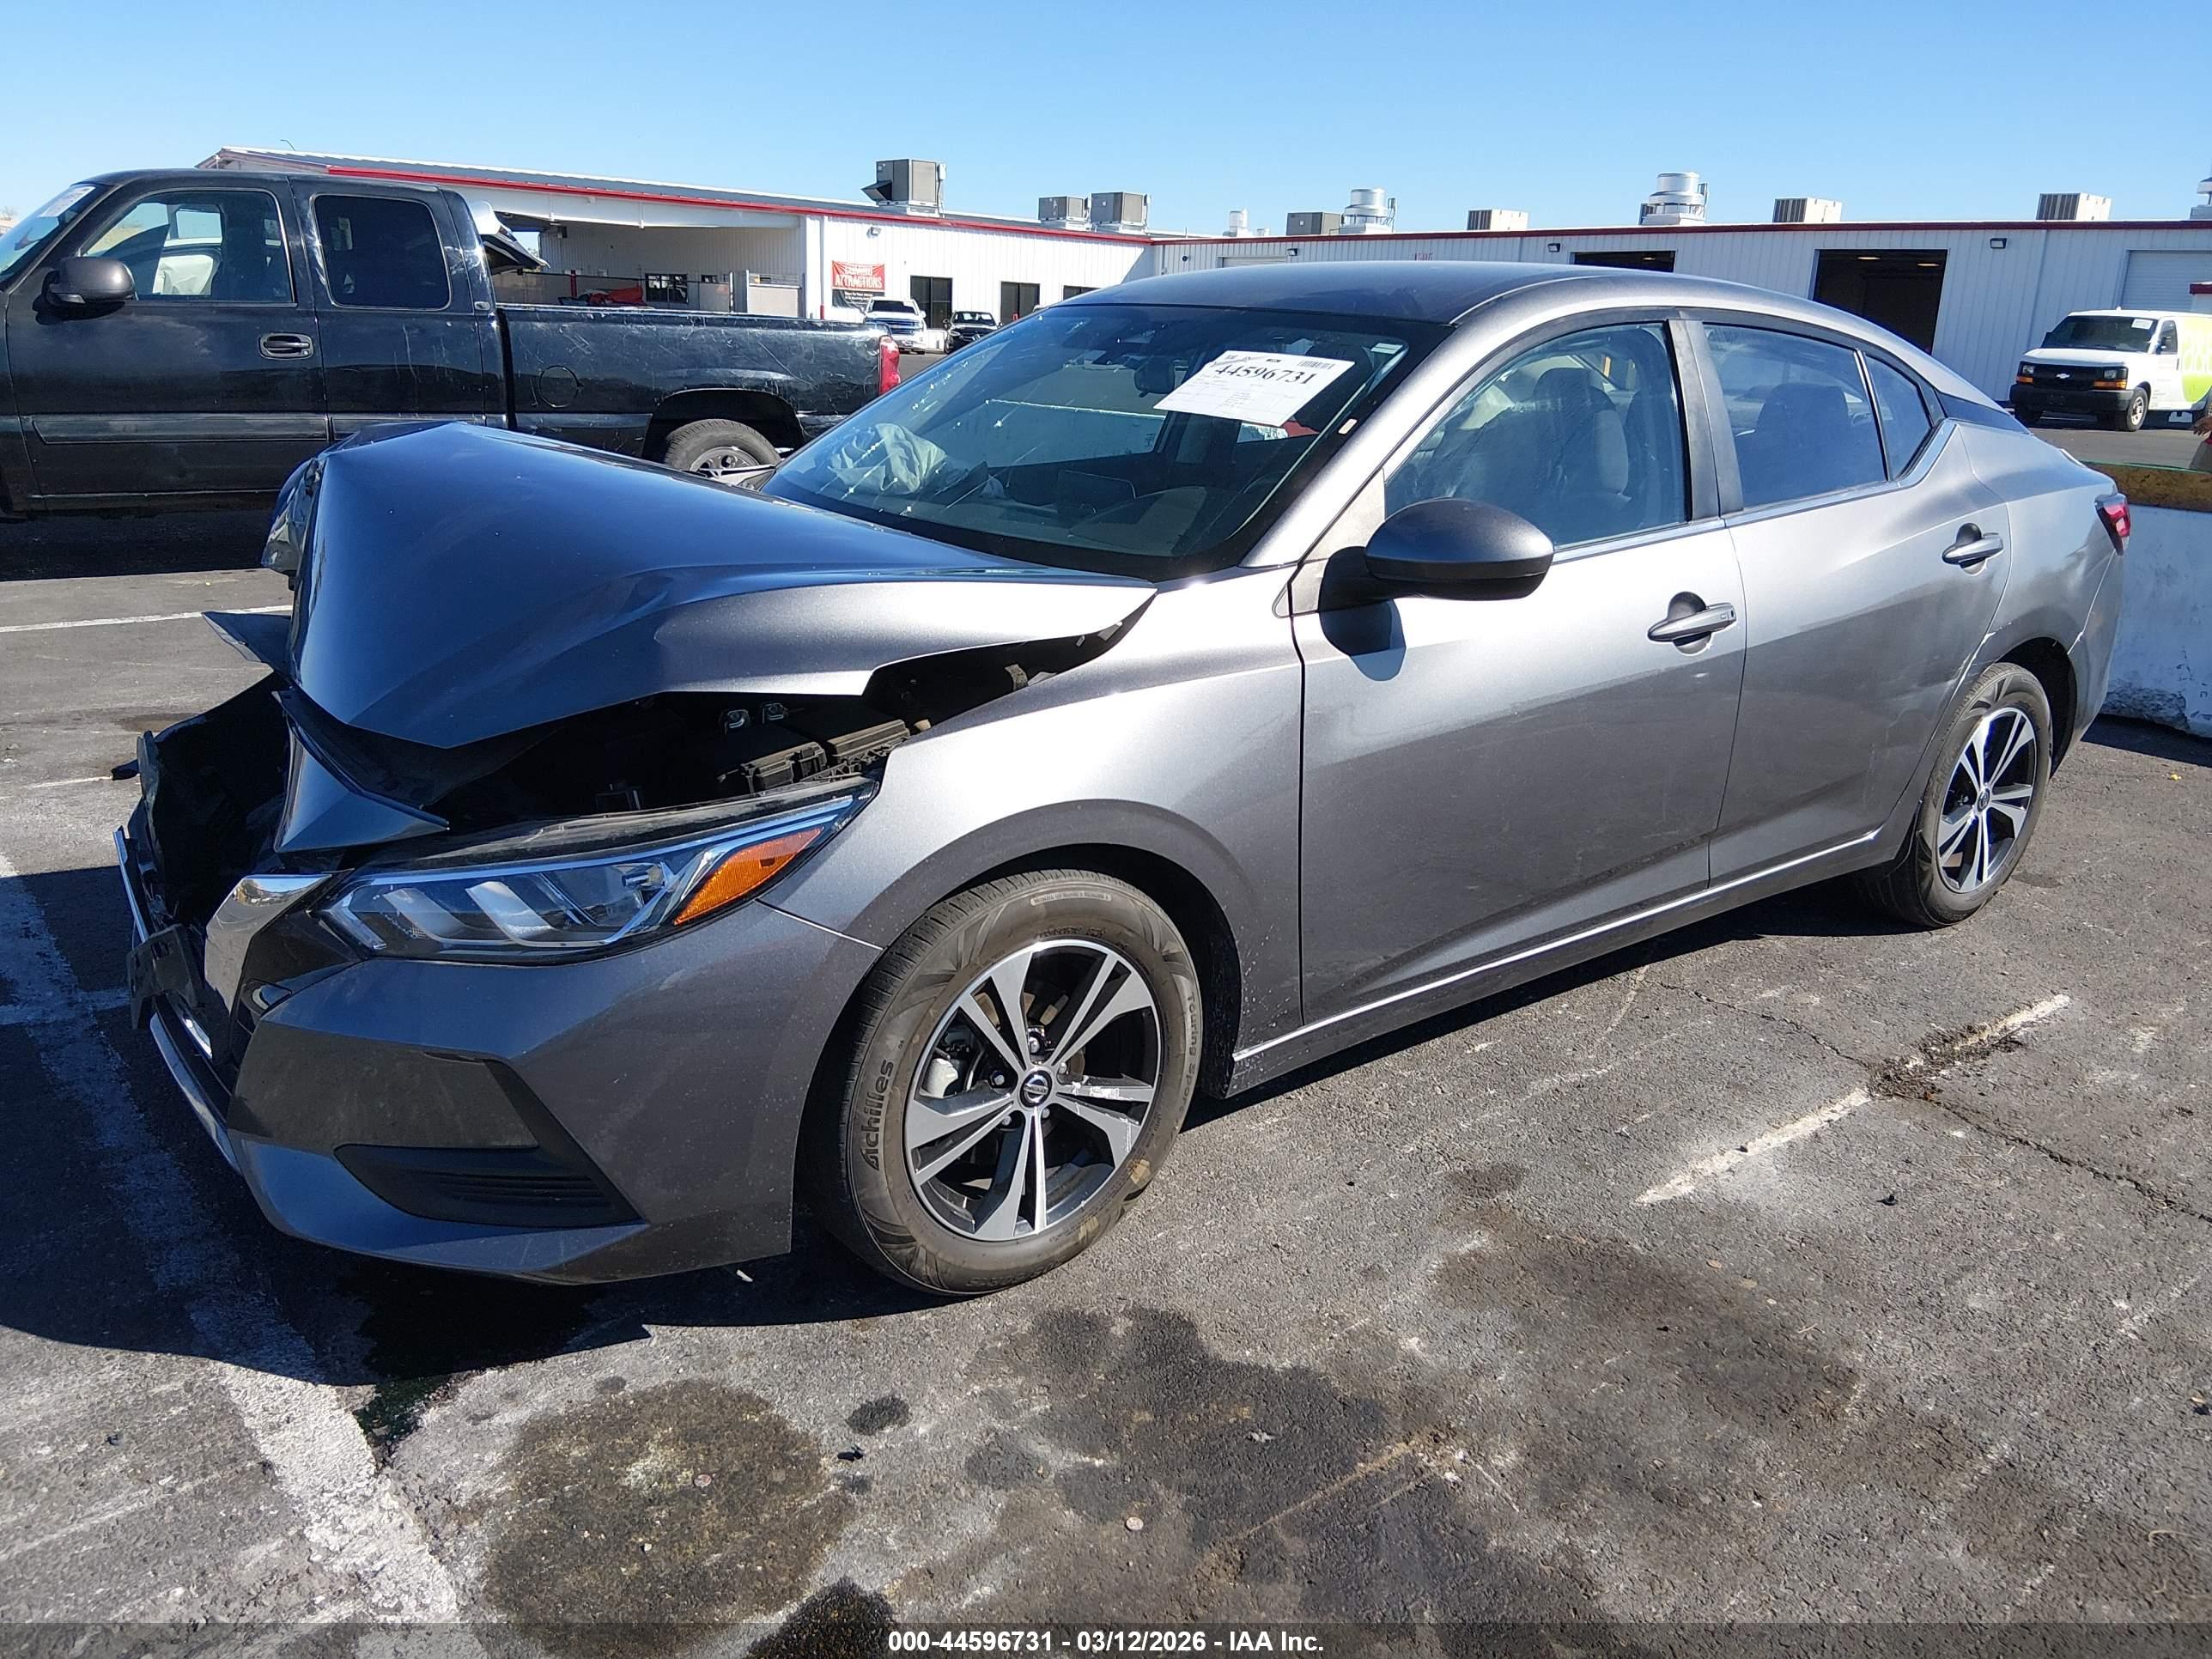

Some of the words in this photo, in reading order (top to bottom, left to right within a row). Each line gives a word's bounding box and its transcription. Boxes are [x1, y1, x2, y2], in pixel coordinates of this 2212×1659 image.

[835, 274, 883, 289] ATTRACTIONS
[1215, 364, 1317, 384] 44596731
[1187, 991, 1197, 1056] Touring
[860, 1059, 895, 1171] Achilles
